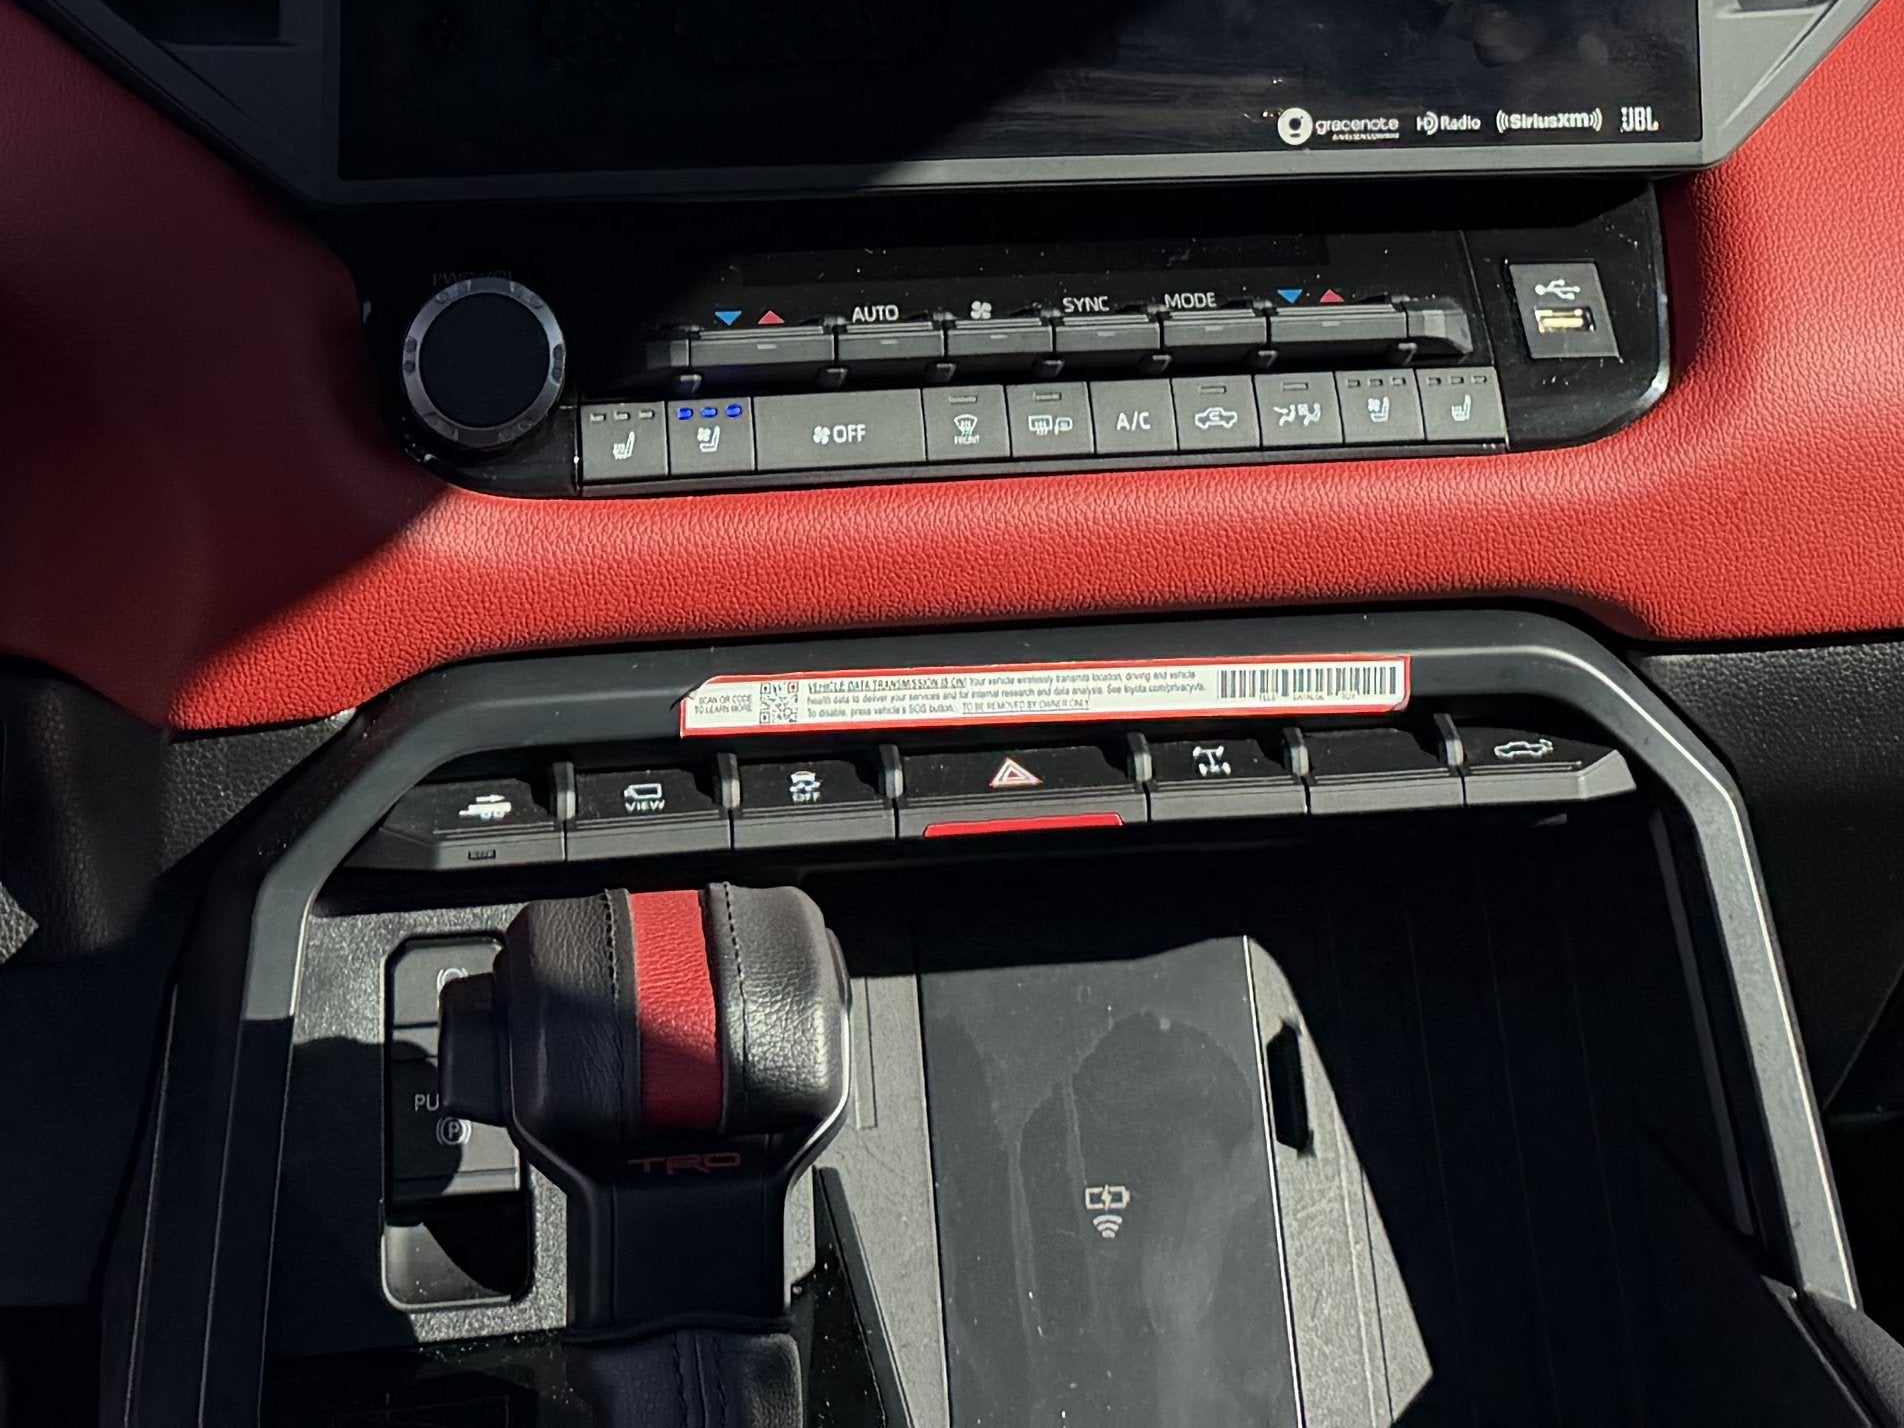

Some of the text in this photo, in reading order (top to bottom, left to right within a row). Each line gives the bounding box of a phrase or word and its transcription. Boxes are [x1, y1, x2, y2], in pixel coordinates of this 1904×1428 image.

[1315, 117, 1400, 136] gracenote
[1440, 114, 1481, 132] Radio
[1622, 106, 1659, 132] JBL
[1061, 295, 1109, 314] SYNC
[1164, 291, 1217, 310] MODE
[852, 305, 899, 323] AUTO
[1116, 409, 1151, 431] A/C
[833, 424, 866, 443] OFF
[953, 432, 981, 445] FRONT
[847, 680, 871, 692] DATA
[969, 677, 986, 687] Your
[988, 676, 1015, 686] vehicle
[1055, 674, 1090, 684] transmits
[1153, 670, 1168, 681] and
[833, 694, 851, 704] data
[862, 693, 889, 703] deliver
[1001, 687, 1035, 698] research
[1037, 686, 1052, 696] and
[1107, 684, 1121, 695] See
[909, 704, 927, 714] SOS
[624, 799, 665, 813] VIEW
[627, 1151, 742, 1176] TRD
